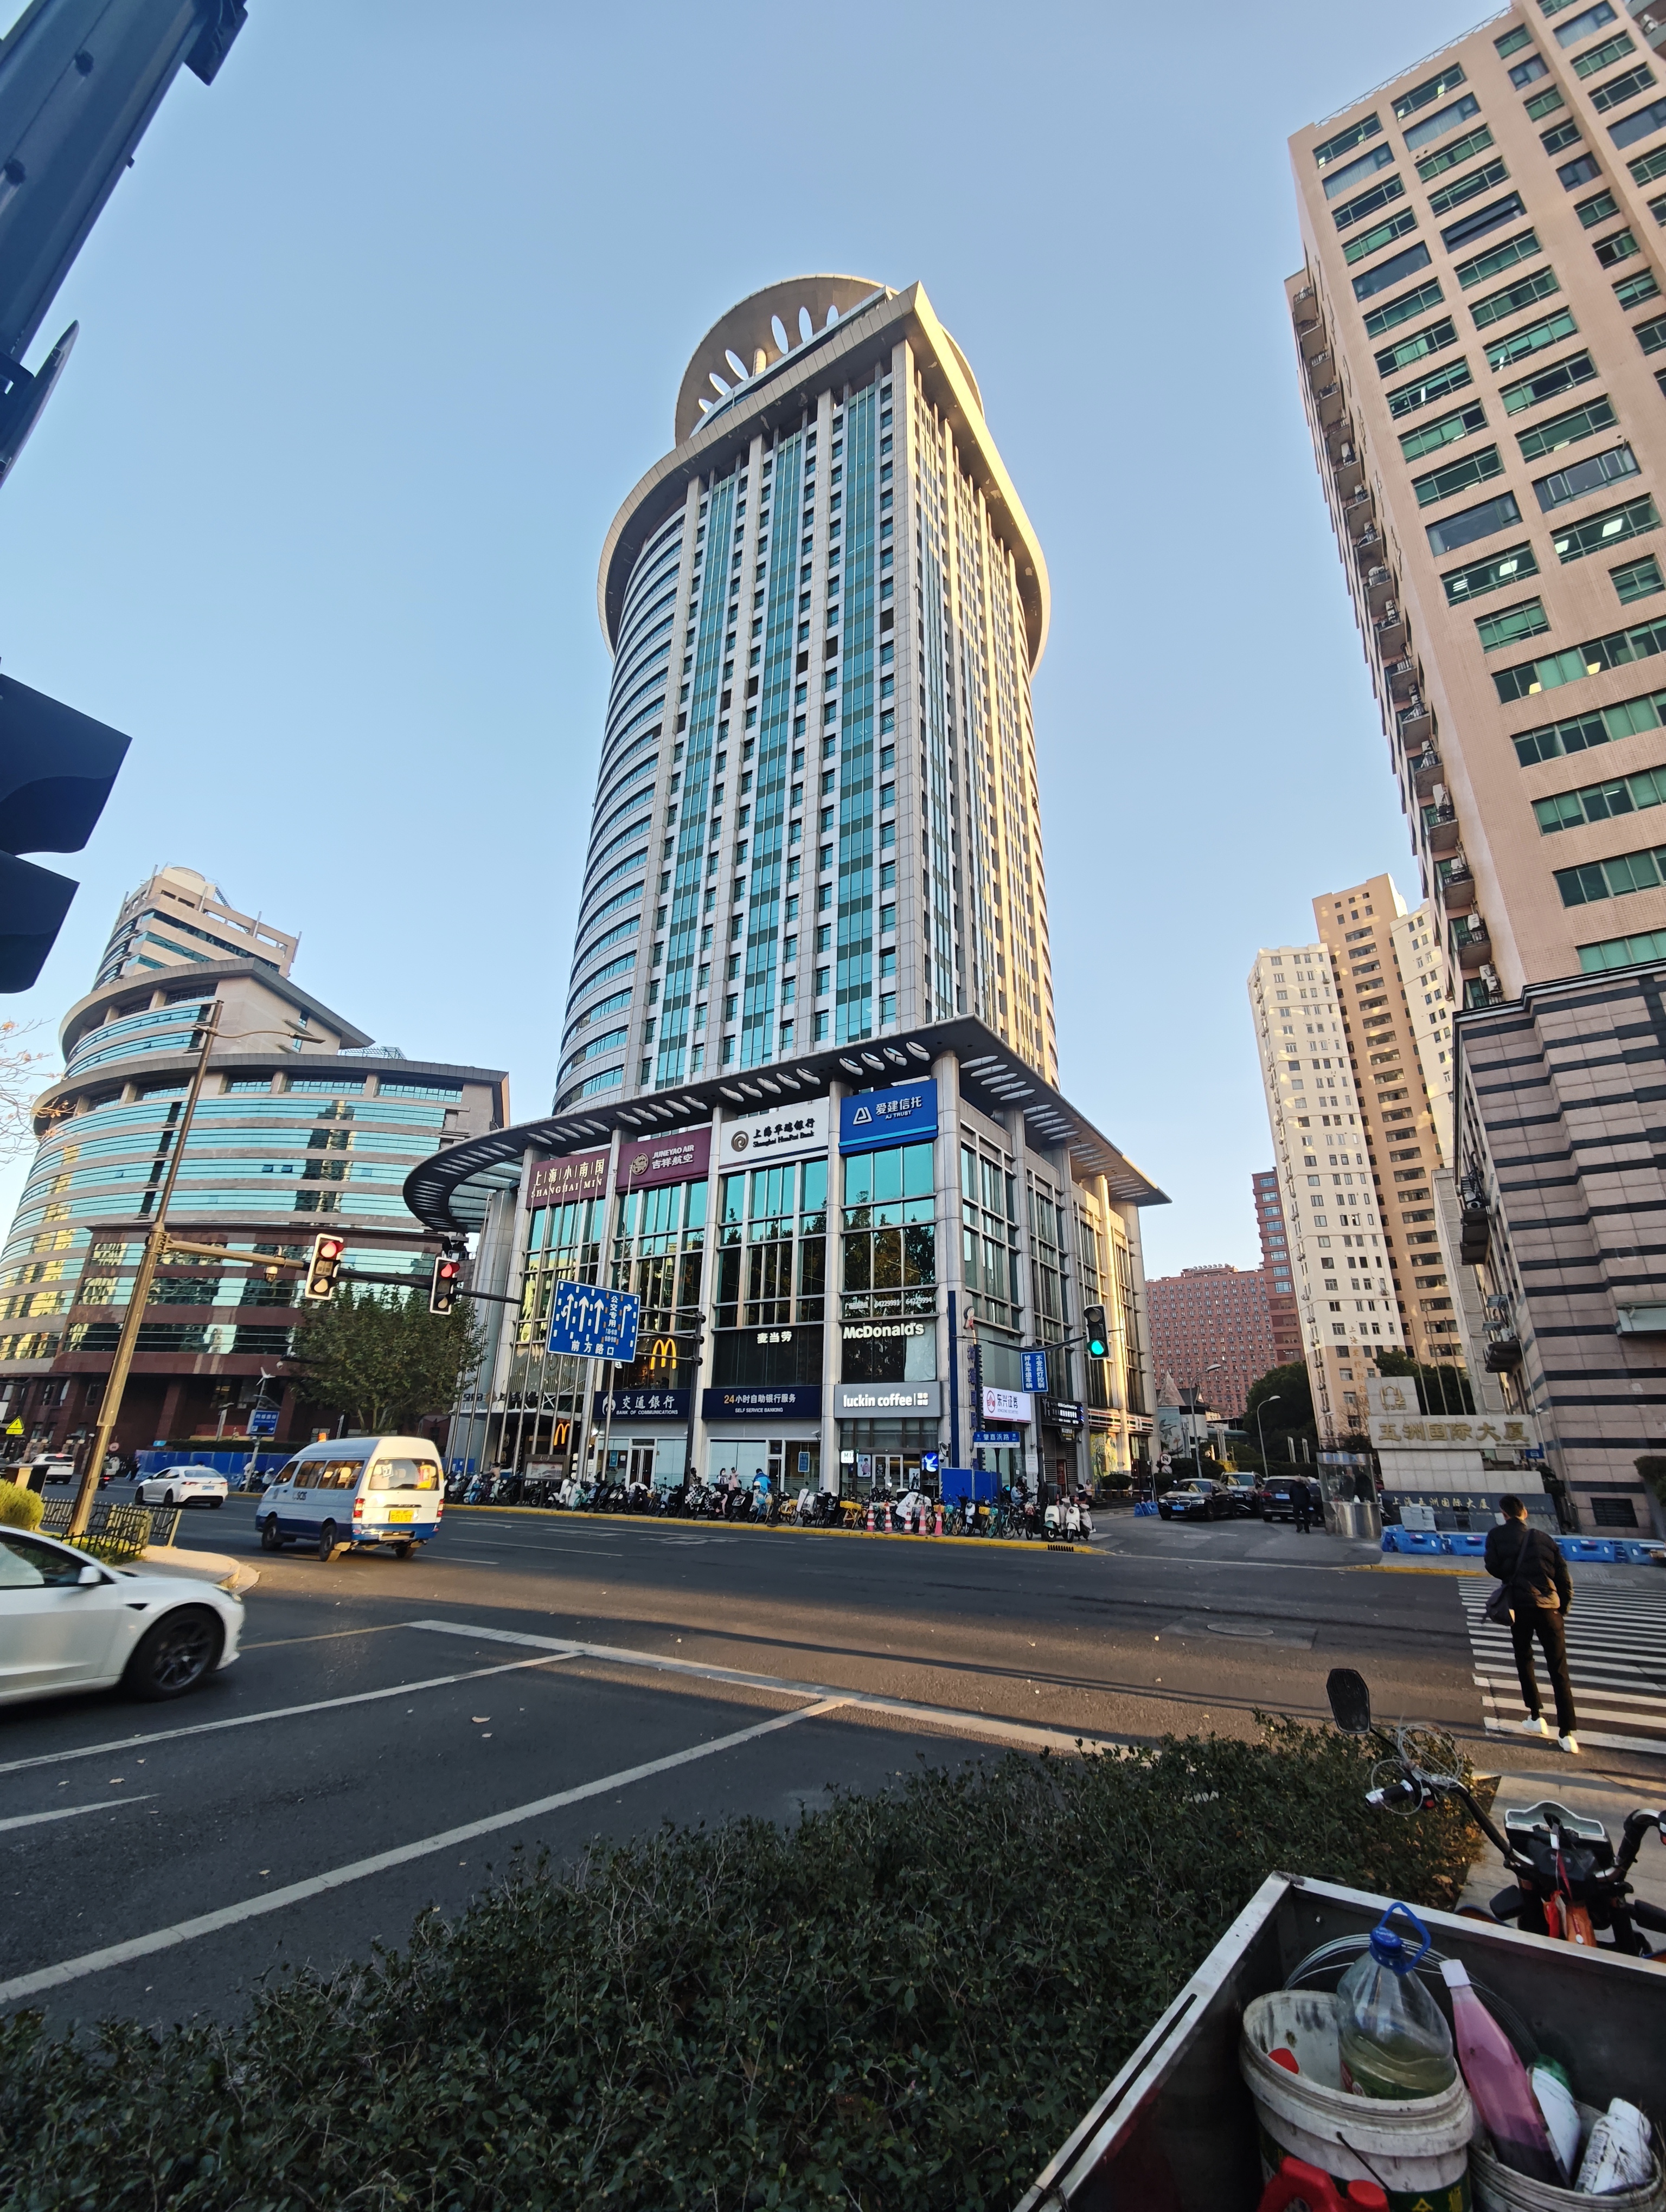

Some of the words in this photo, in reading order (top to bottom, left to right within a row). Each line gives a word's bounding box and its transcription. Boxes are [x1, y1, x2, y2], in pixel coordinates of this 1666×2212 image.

[875, 1096, 922, 1115] 爱建信托
[753, 1138, 776, 1148] Shanghai
[800, 1130, 815, 1139] Bank
[652, 1147, 682, 1159] JUNEYAO
[682, 1144, 694, 1153] AIR
[652, 1153, 693, 1169] 吉祥航空
[531, 1182, 579, 1198] SHANGHAI
[584, 1179, 602, 1189] MIN
[608, 1295, 619, 1328] 公交专用
[757, 1331, 792, 1343] 麦当劳
[843, 1322, 924, 1339] McDonald's
[571, 1339, 615, 1356] 前方路口
[1036, 1355, 1045, 1388] 不受此灯控制
[621, 1395, 675, 1409] 交通銀行
[724, 1393, 796, 1404] 24小时自助银行服务
[843, 1394, 875, 1407] luckin
[877, 1393, 912, 1407] coffee
[997, 1394, 1018, 1409] 东兴证券
[1378, 1421, 1530, 1442] 五洲国际大厦
